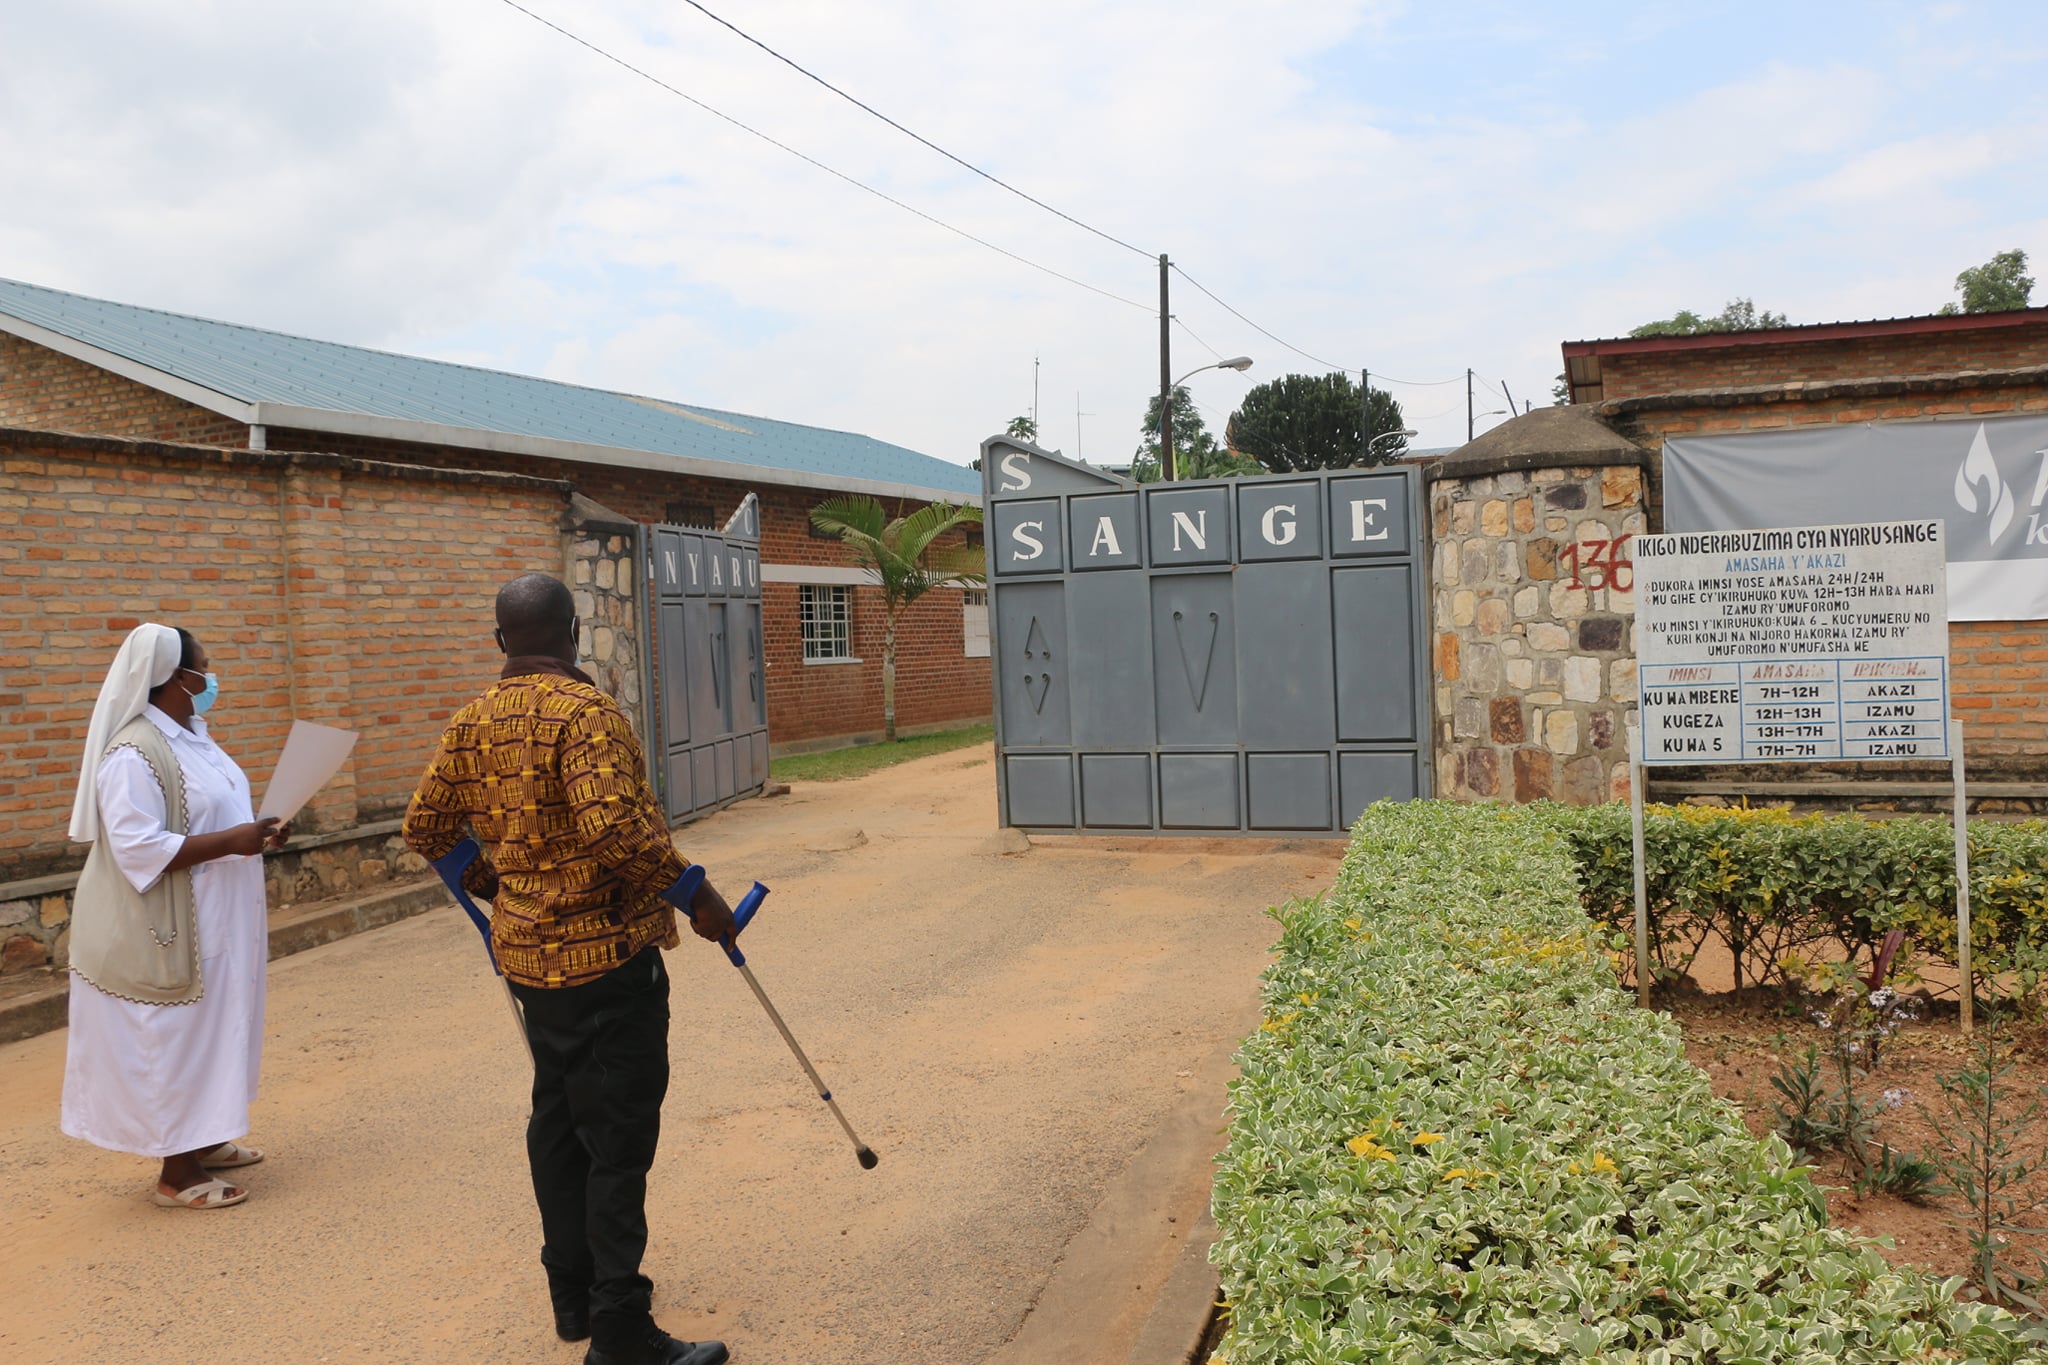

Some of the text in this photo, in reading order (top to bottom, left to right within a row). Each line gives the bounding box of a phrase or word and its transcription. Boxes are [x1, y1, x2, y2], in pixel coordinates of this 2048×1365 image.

[999, 452, 1032, 492] S
[1010, 498, 1389, 562] SANGE
[1638, 523, 1937, 557] IKIGO NDERABUZIMA CYA NYARUSANGE
[665, 551, 756, 587] NYARU
[1725, 553, 1846, 572] AMASAHA Y'AKAZI
[1651, 571, 1884, 592] DUKORA IMINSI YOSE AMASAHA 24H/24H
[1652, 594, 1667, 605] MU
[1670, 593, 1696, 604] GIHE
[1813, 586, 1866, 599] 12H-13H
[1869, 585, 1901, 597] HABA
[1905, 584, 1935, 596] HARI
[1722, 604, 1757, 616] IZAMU
[1652, 622, 1667, 633] KU
[1670, 620, 1699, 632] MINSI
[1809, 615, 1817, 626] 6
[1832, 613, 1911, 626] KUCYUMWERU
[1914, 612, 1930, 624] NO
[1667, 634, 1692, 645] KURI
[1695, 632, 1728, 643] KONJI
[1731, 631, 1745, 642] NA
[1749, 629, 1791, 641] NIJORO
[1794, 628, 1848, 640] HAKORWA
[1851, 627, 1887, 638] IZAMU
[1707, 643, 1776, 656] UMUFOROMO
[1854, 640, 1869, 652] WE
[1669, 667, 1713, 681] IMINSI
[1760, 686, 1820, 699] 7H-12H
[1867, 684, 1916, 697] AKAZI
[1756, 707, 1822, 720] 12H-13H
[1866, 705, 1916, 717] IZAMU
[1663, 714, 1724, 729] KUGEZA
[1757, 726, 1824, 737] 13H-17H
[1868, 725, 1916, 737] AKAZI
[1713, 737, 1723, 751] 5
[1757, 744, 1816, 756] 17H-7H
[1868, 744, 1917, 755] IZAMU
